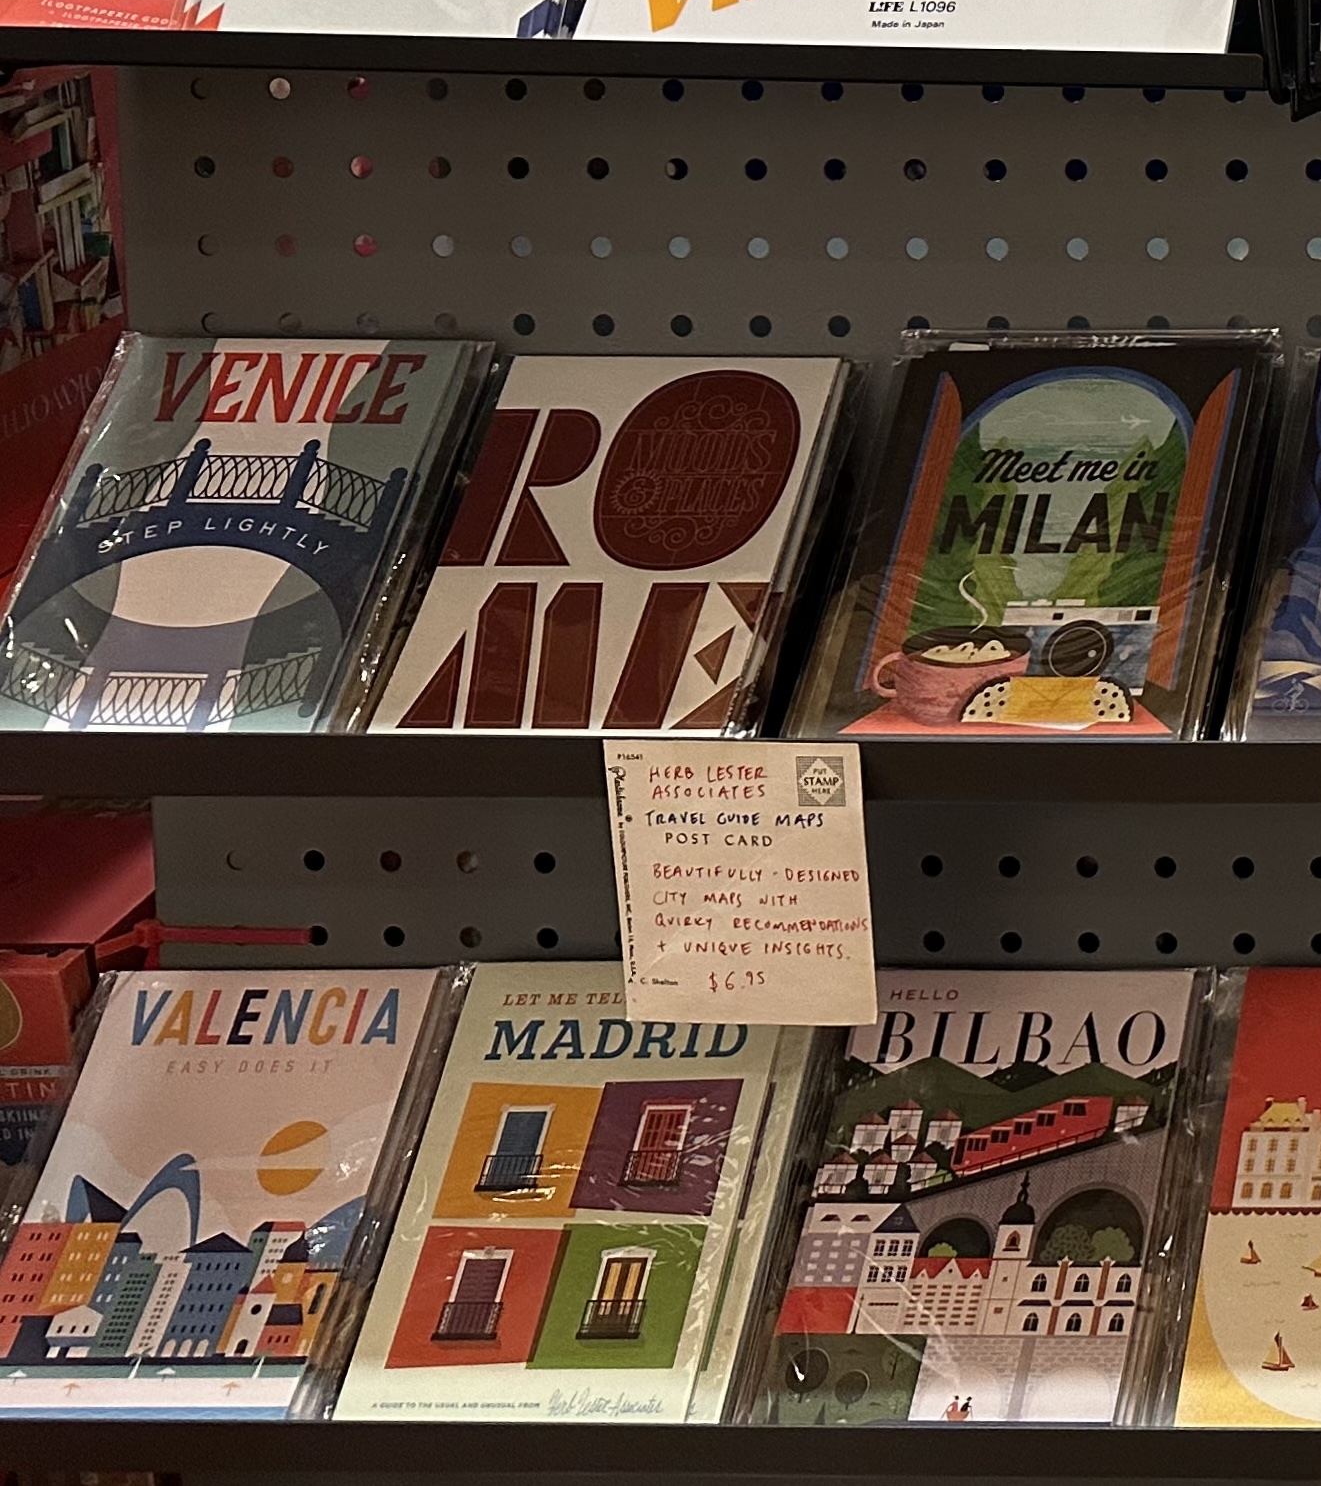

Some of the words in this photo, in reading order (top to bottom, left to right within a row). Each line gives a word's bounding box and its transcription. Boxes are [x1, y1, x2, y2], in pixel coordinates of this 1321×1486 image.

[871, 18, 900, 29] Made
[902, 18, 912, 28] in
[915, 18, 945, 31] Japan
[153, 351, 429, 425] VENICE
[972, 448, 1067, 484] Meet
[1067, 456, 1119, 483] me
[1123, 449, 1159, 482] in
[937, 491, 1170, 555] MILAN
[98, 518, 185, 554] STEP
[203, 516, 330, 556] LIGHTLY
[649, 764, 694, 783] HERB
[706, 764, 769, 783] LESTER
[652, 783, 767, 800] ASSOCIATES
[645, 809, 707, 827] TRAVEL
[716, 812, 760, 826] GUIDE
[775, 812, 825, 828] MAPS
[665, 831, 711, 844] POST
[724, 833, 773, 847] CARD
[653, 862, 763, 882] BEAUTIFULLY
[784, 868, 861, 883] DESIGNED
[652, 889, 688, 906] CITY
[703, 891, 743, 908] MAPS
[758, 893, 799, 906] WITH
[503, 992, 541, 1007] LET
[546, 991, 578, 1006] ME
[889, 987, 960, 1001] HELLO
[131, 985, 400, 1048] VALENCIA
[483, 1017, 749, 1061] MADRID
[873, 1008, 1167, 1067] BILBAO
[165, 1058, 226, 1076] EASY
[237, 1058, 295, 1076] DOES
[309, 1057, 334, 1074] IT
